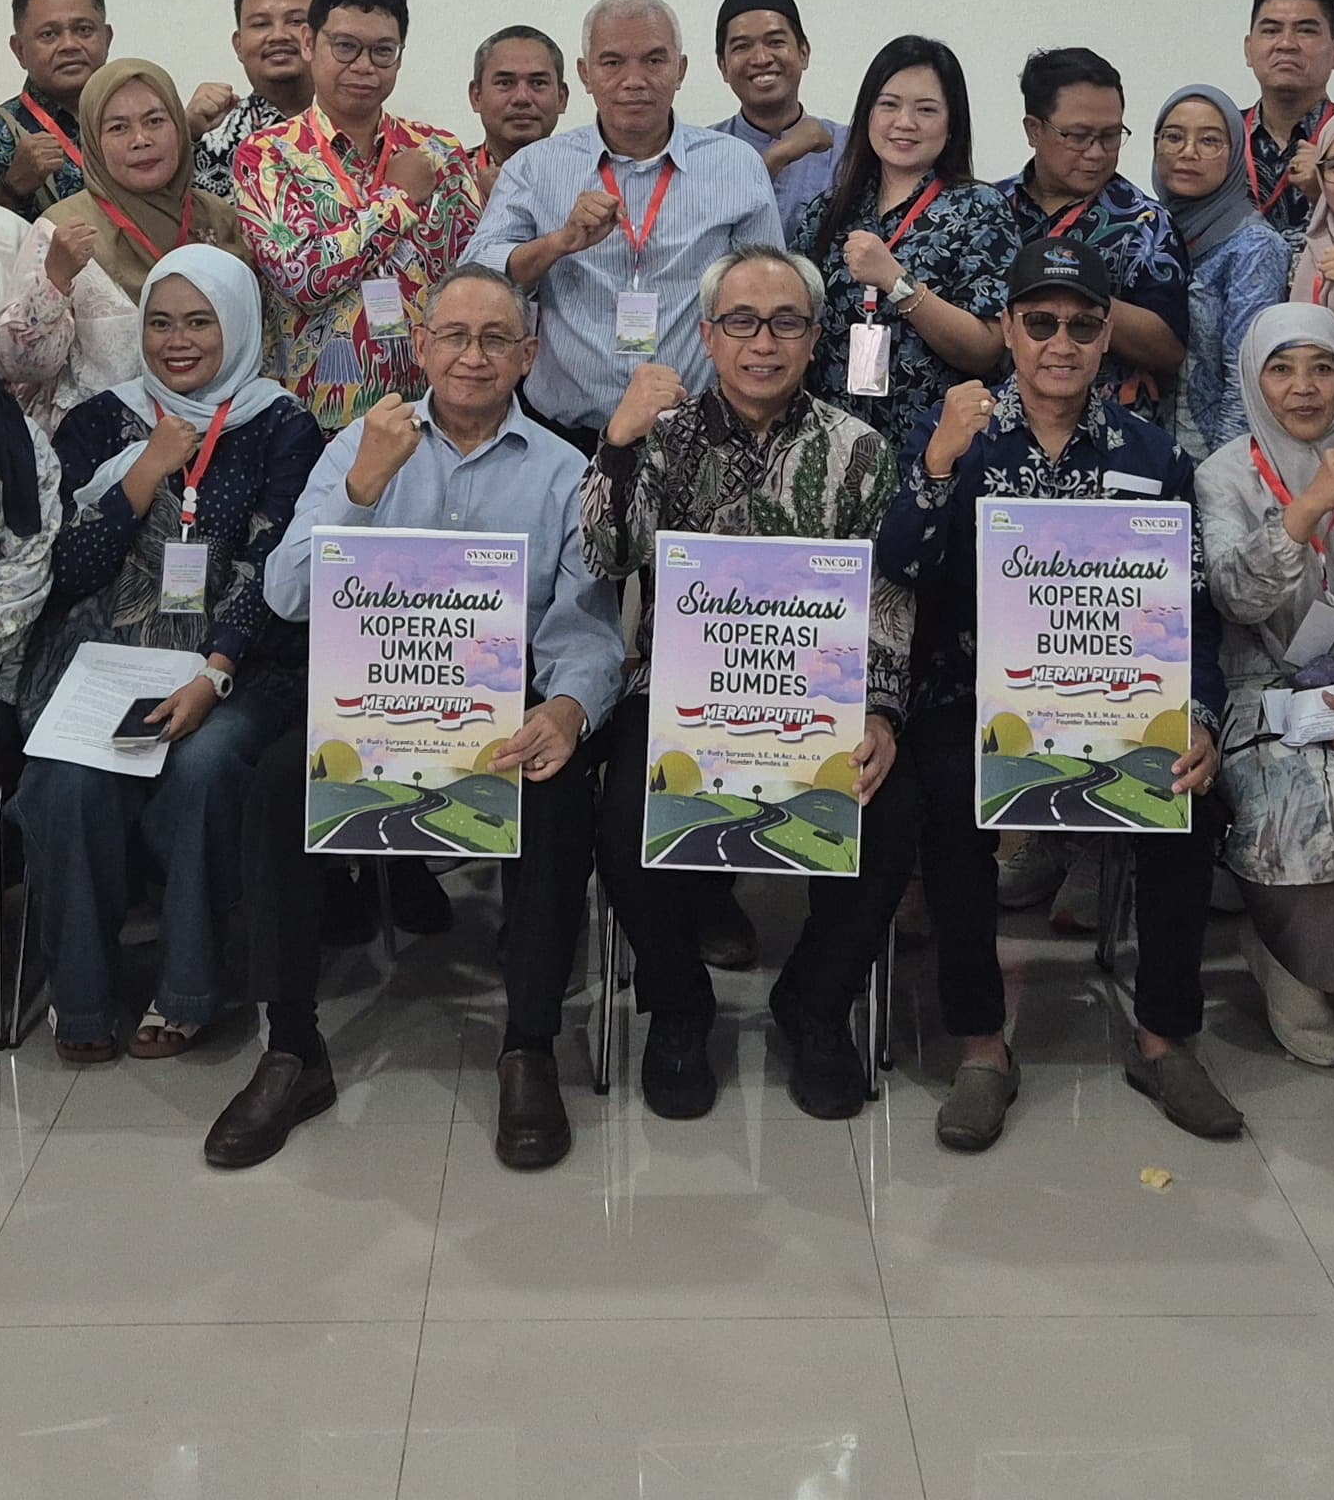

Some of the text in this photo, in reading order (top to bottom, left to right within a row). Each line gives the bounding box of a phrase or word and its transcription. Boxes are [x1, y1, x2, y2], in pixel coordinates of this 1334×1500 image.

[1132, 519, 1180, 528] SYNCORE
[467, 551, 517, 560] SYNCORE
[811, 557, 861, 568] SYNCORE
[1002, 545, 1168, 579] Sinkronisasi
[333, 576, 502, 611] Sinkronisasi
[677, 581, 846, 620] Sinkronisasi
[1029, 585, 1141, 608] KOPERASI
[361, 616, 474, 638] KOPERASI
[1050, 610, 1119, 631] UMKM
[704, 623, 817, 647] KOPERASI
[1037, 634, 1133, 655] BUMDES
[381, 640, 452, 661] UMKM
[725, 648, 795, 671] UMKM
[368, 664, 464, 685] BUMDES
[711, 672, 807, 696] BUMDES
[1031, 665, 1140, 683] MERAH PUTIH
[361, 694, 473, 713] MERAH PUTIH
[701, 704, 814, 724] MERAH PUTIH
